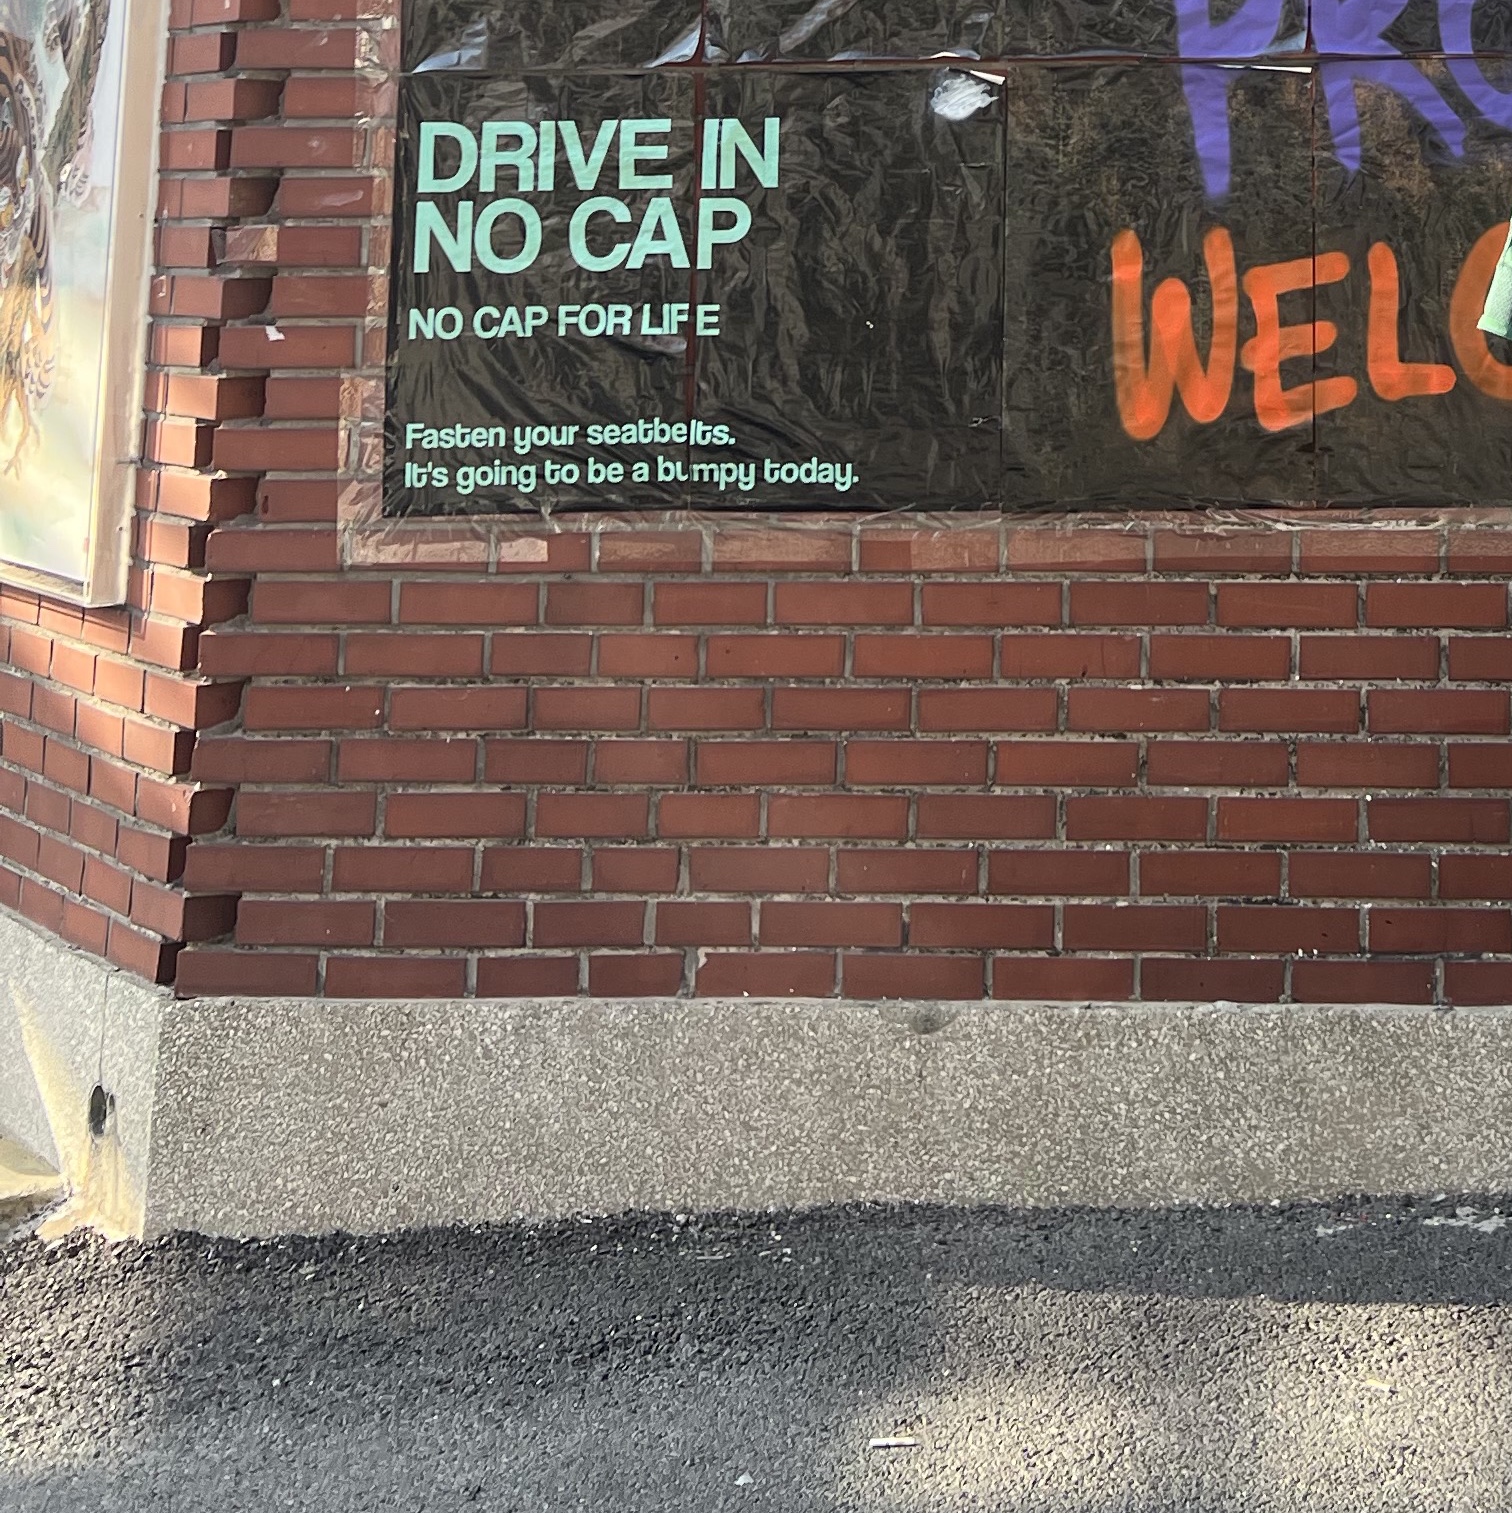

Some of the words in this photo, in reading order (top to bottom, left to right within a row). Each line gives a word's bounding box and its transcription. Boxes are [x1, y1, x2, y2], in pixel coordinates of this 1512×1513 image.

[417, 118, 673, 193] DRIVE
[701, 116, 780, 190] IN
[412, 196, 543, 274] NO
[568, 195, 753, 272] CAP
[408, 306, 463, 340] NO
[472, 305, 549, 339] CAP
[558, 303, 632, 337] FOR
[640, 302, 721, 336] LIFE
[405, 423, 506, 449] Fasten
[513, 424, 580, 455] your
[586, 417, 737, 446] seatbelts.
[404, 461, 449, 488] It's
[456, 459, 537, 495] going
[544, 459, 580, 485] to
[587, 456, 625, 484] be
[631, 461, 651, 483] a
[656, 455, 756, 491] bumpy
[763, 456, 860, 491] today.
